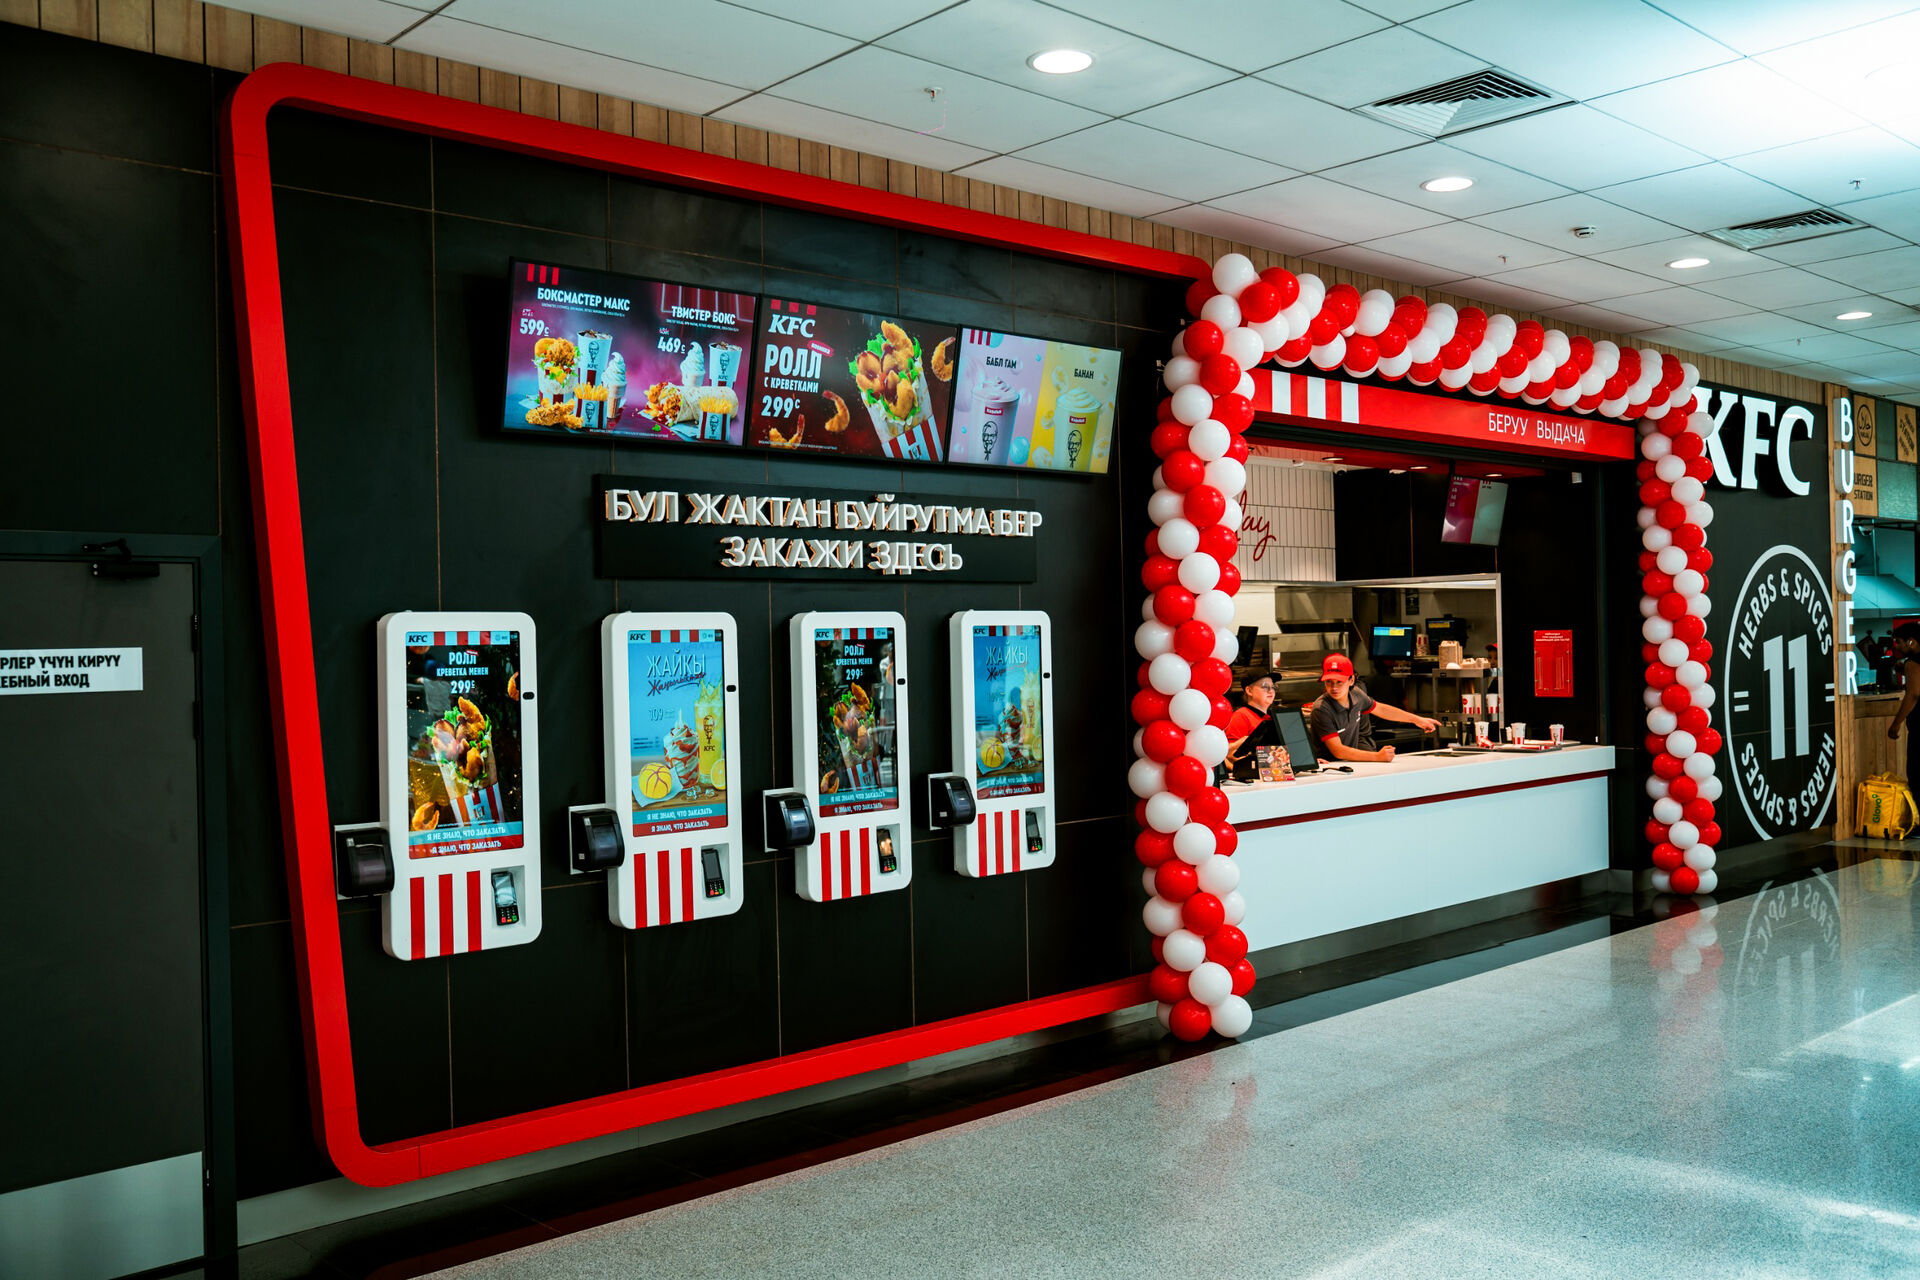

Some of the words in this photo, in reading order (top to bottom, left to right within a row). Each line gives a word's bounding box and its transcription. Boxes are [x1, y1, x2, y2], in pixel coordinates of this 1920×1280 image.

[537, 287, 602, 308] БОКСМАСТЕР
[603, 296, 630, 311] МАКС
[671, 305, 711, 322] ТВИСТЕР
[712, 311, 736, 325] БОКС
[768, 313, 817, 338] KFC
[764, 343, 823, 380] РОЛЛ
[986, 356, 1004, 367] БАБЛ
[1004, 359, 1017, 369] ГАМ
[1074, 368, 1095, 379] БАНАН
[764, 376, 769, 388] С
[770, 377, 819, 394] КРЕВЕТКАМИ
[1488, 412, 1529, 437] БЕРУУ
[1536, 419, 1587, 445] ВЫДАЧА
[1692, 386, 1815, 496] KFC
[1854, 472, 1873, 487] URGER
[1854, 489, 1873, 501] STATION
[606, 489, 679, 523] БУЛ
[685, 493, 831, 528] ЖАКТАН
[835, 494, 992, 535] БУЙРУТМА
[990, 509, 1043, 537] БЕР
[721, 536, 863, 568] ЗАКАЖИ
[868, 541, 963, 575] ЗДЕСЬ
[1837, 397, 1859, 695] BURGER
[1738, 574, 1777, 660] HERBS
[1780, 568, 1790, 597] &
[1793, 572, 1833, 656] SPICES
[408, 635, 428, 643] KFC
[844, 645, 864, 656] РОЛЛ
[39, 655, 74, 669] ҮЧҮН
[78, 655, 121, 668] КИРҮҮ
[448, 651, 477, 665] РОЛЛ
[647, 648, 707, 678] ЖАЙКЫ
[985, 640, 1027, 666] ЖАЙКЫ
[0, 671, 50, 688] ЕБНЫЙ
[54, 673, 90, 688] ВХОД
[436, 668, 467, 676] КРЕВЕТКА
[468, 667, 489, 676] МЕНЕН
[1763, 632, 1810, 760] 11
[1741, 742, 1784, 826] SPICES
[1801, 732, 1835, 818] HERBS
[1788, 797, 1798, 827] &
[1872, 798, 1882, 824] Glovo
[443, 831, 462, 839] ЗНАЮ,
[476, 826, 506, 836] ЗАКАЗАТЬ
[438, 844, 458, 853] ЗНАЮ,
[459, 843, 471, 851] ЧТО
[472, 840, 502, 850] ЗАКАЗАТЬ
